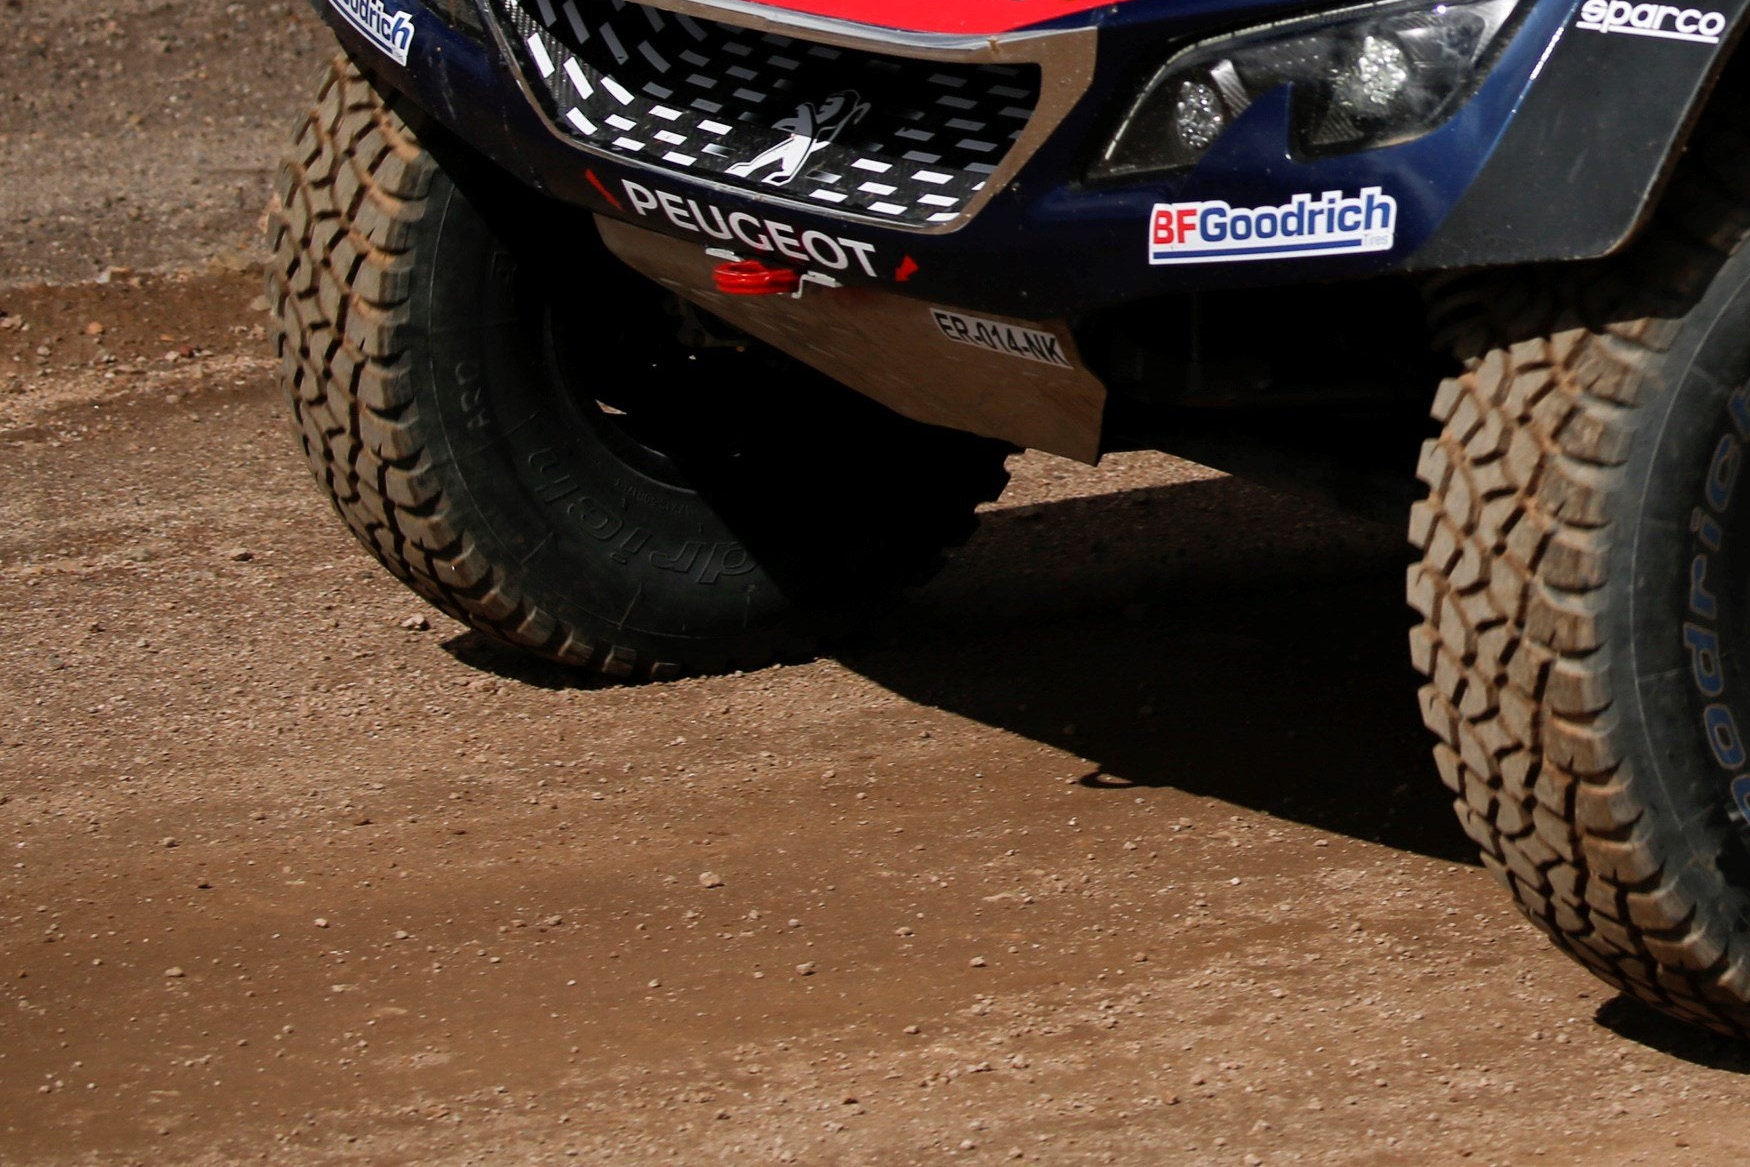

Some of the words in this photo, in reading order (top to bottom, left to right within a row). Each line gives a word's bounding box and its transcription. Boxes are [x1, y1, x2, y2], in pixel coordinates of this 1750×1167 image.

[621, 178, 876, 278] PEUGEOT
[1153, 194, 1390, 245] BFGoodrich
[936, 312, 1064, 366] ER-014-NK
